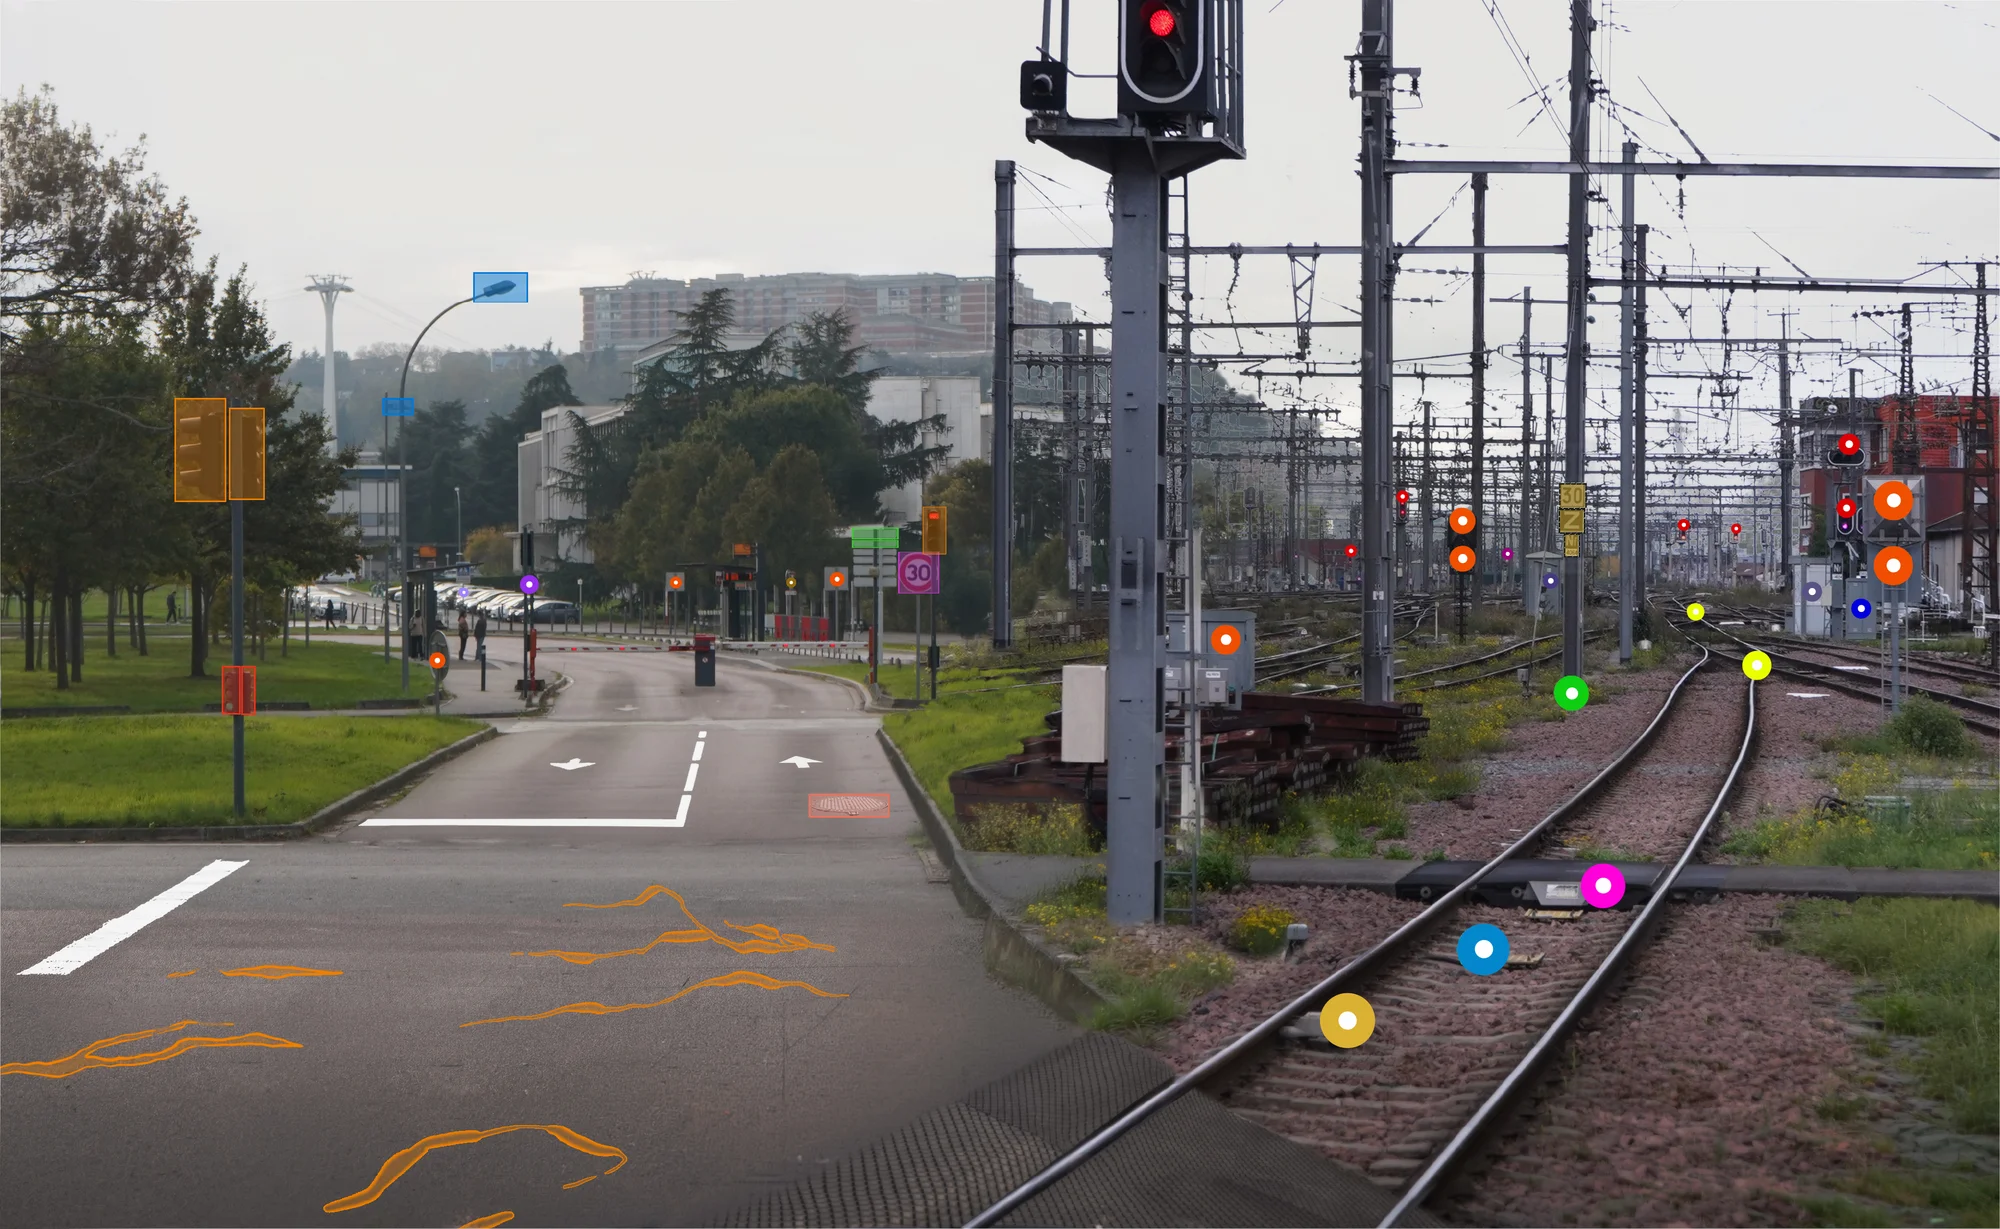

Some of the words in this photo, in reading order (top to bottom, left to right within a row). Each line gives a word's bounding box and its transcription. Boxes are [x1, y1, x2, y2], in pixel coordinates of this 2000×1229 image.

[1562, 488, 1582, 504] 30
[1563, 511, 1580, 530] Z
[907, 564, 930, 581] 30
